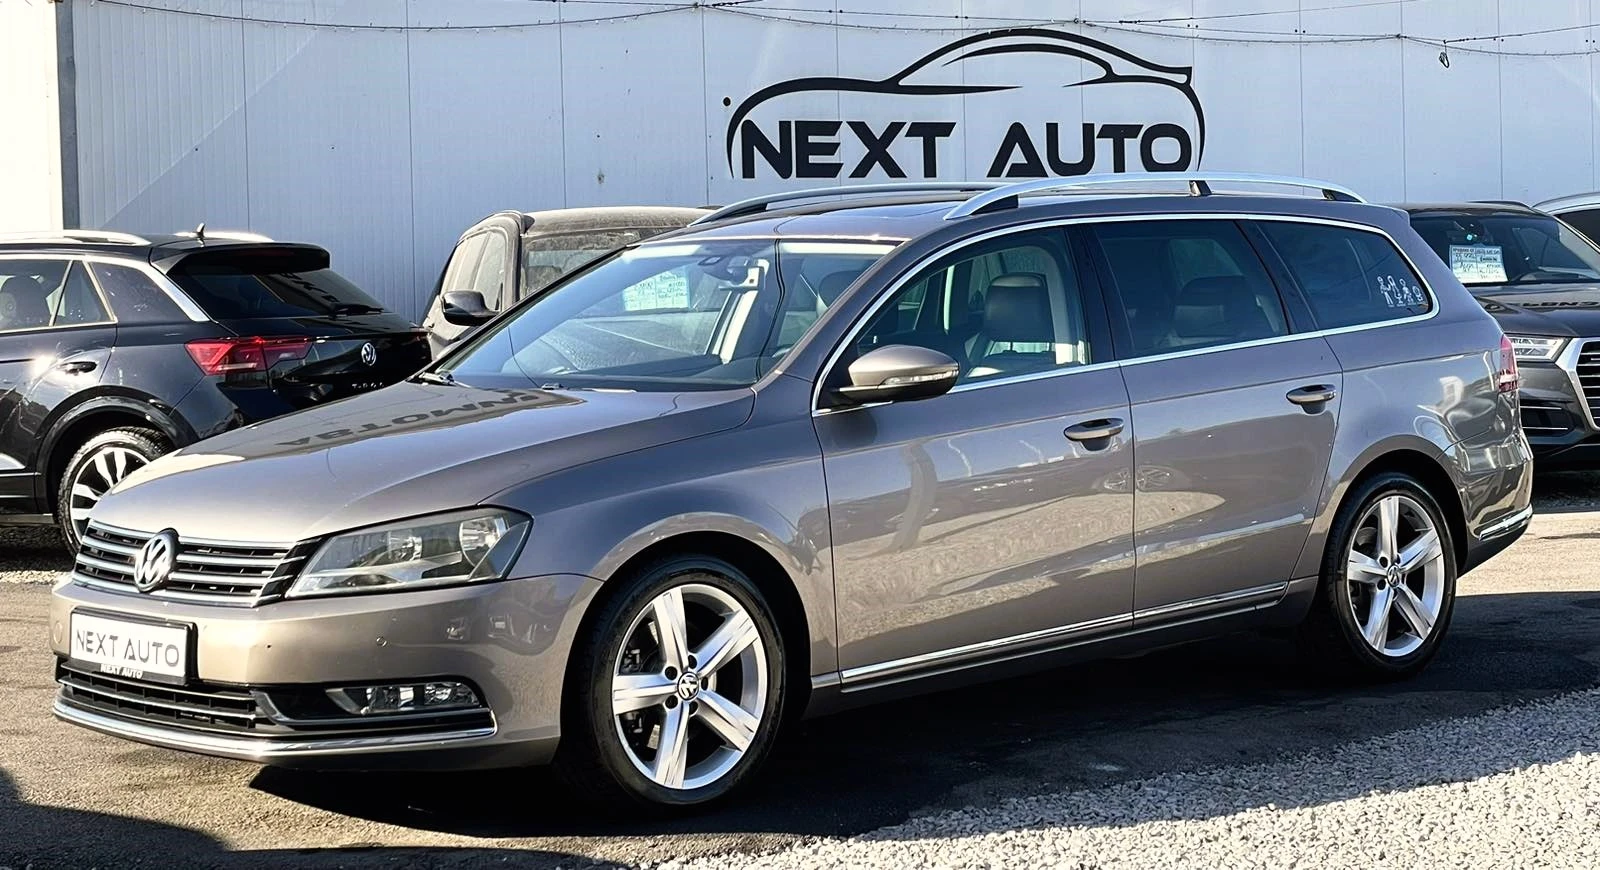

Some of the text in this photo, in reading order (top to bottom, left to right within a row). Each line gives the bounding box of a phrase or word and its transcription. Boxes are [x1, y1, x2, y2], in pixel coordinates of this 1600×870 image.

[741, 119, 1192, 178] NEXT AUTO
[76, 629, 180, 667] NEXT AUTO
[101, 663, 143, 679] NEXT AUTO
